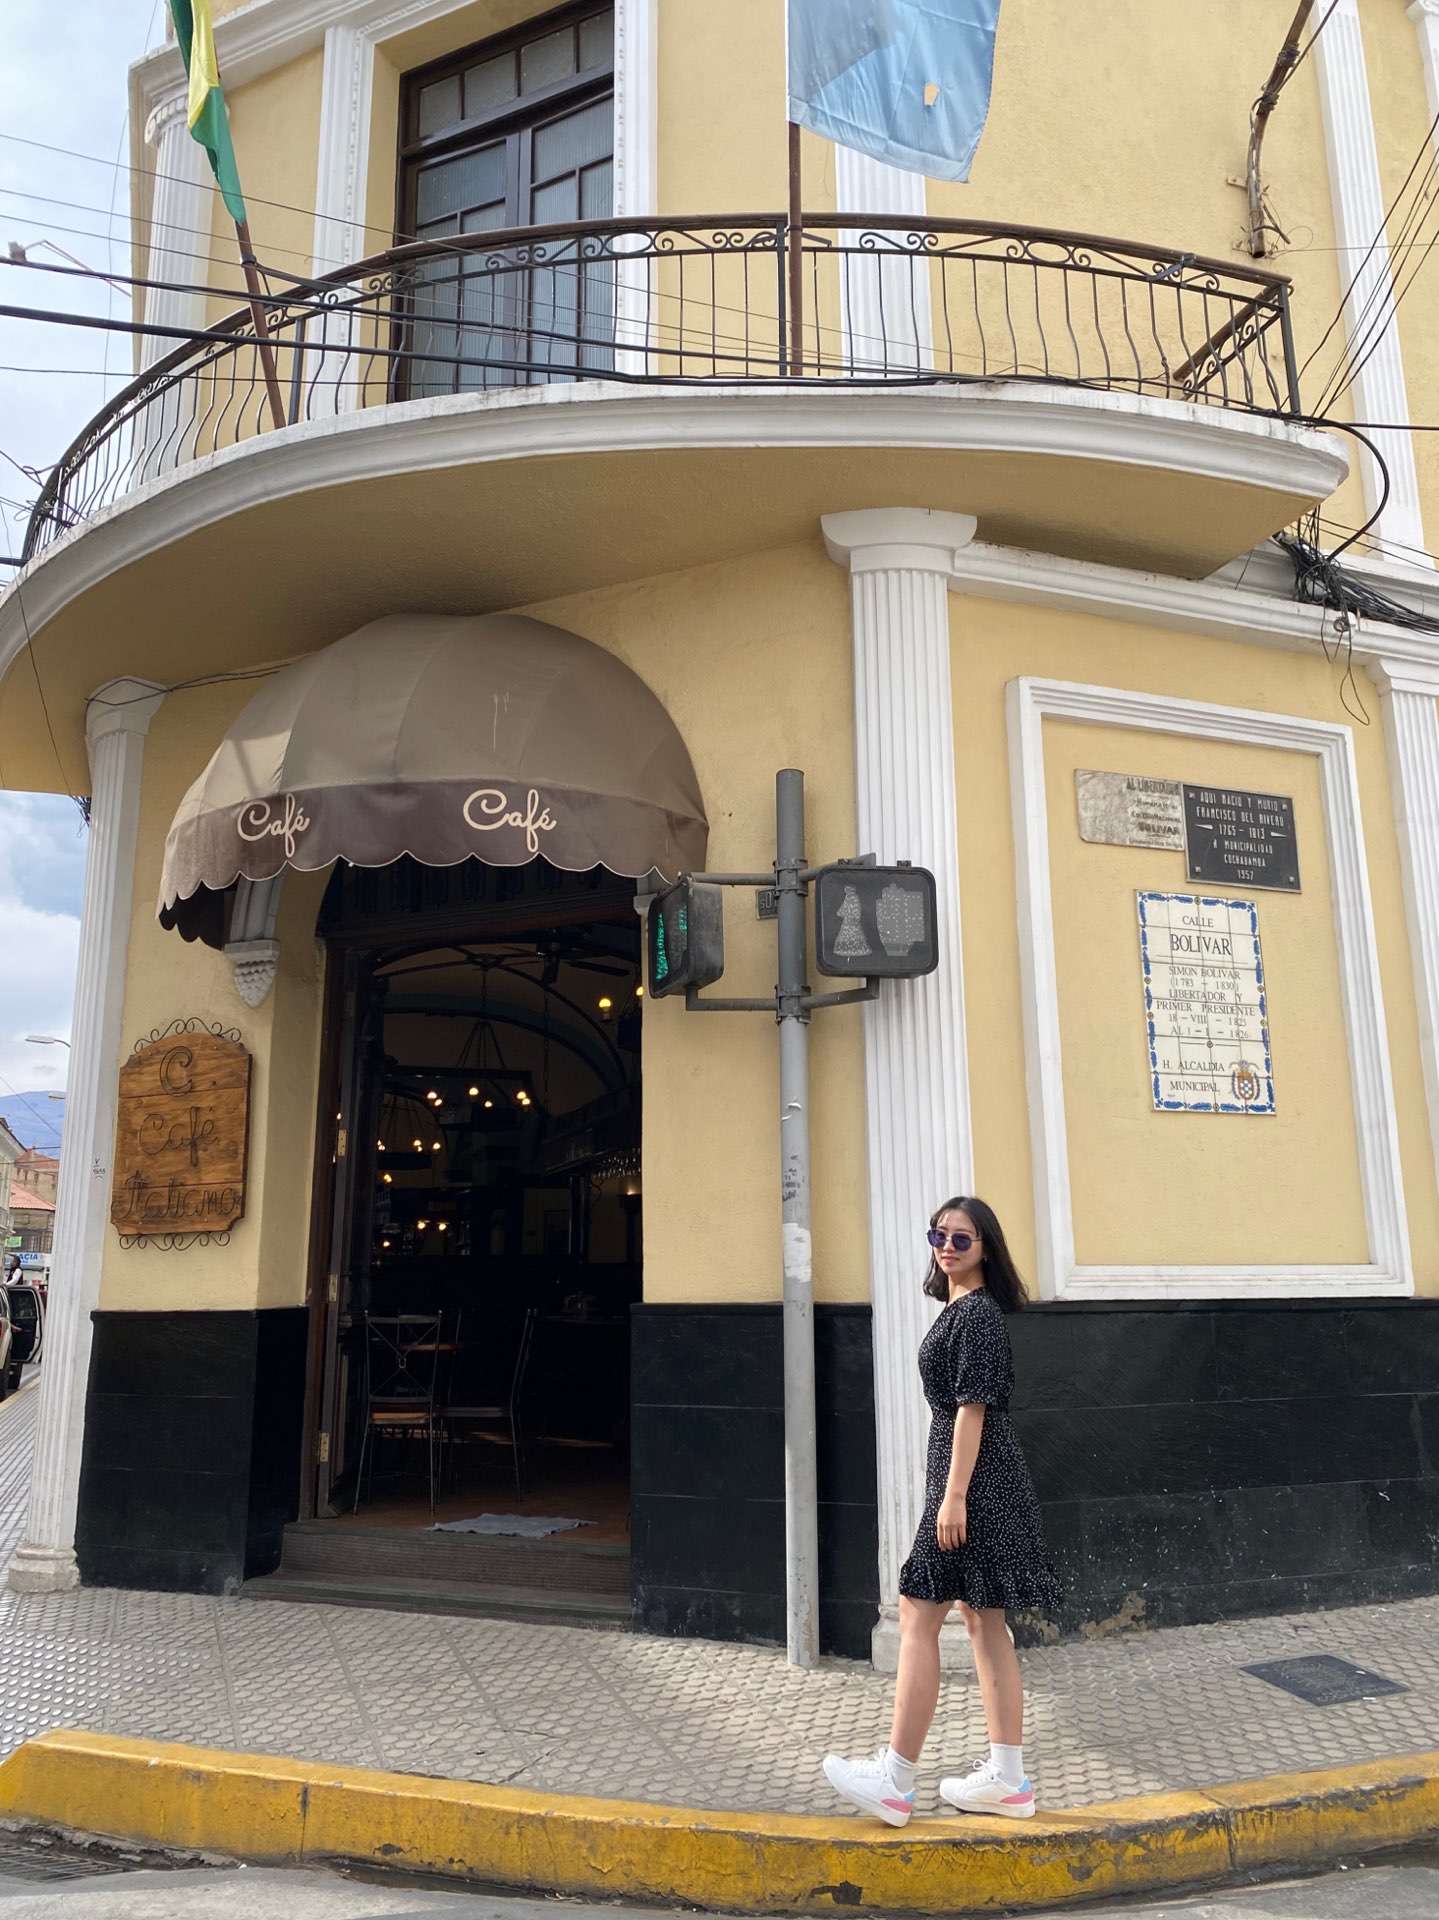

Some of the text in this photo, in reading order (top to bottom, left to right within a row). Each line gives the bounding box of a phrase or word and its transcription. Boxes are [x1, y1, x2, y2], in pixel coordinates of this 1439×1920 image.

[1200, 792, 1278, 812] AQUI NACIO Y MURIO
[463, 789, 557, 853] Café
[1196, 806, 1284, 827] FRANCISCO DEL RIVERO
[237, 792, 310, 858] Café
[1219, 824, 1236, 836] 1765
[1248, 827, 1265, 840] 1813
[1224, 840, 1273, 855] MUNICIPALIDAD
[1224, 854, 1266, 867] COCHABAMBA
[1182, 915, 1214, 928] CALLE
[1170, 933, 1232, 956] BOLIVAR
[1168, 966, 1241, 980] SIMON BOLIVAR
[1169, 989, 1243, 1003] LIBERTADOR Y
[1156, 1000, 1255, 1016] PRIMER PRESIDENTE
[1169, 1013, 1177, 1022] 18
[1171, 1026, 1184, 1035] AL
[159, 1045, 193, 1097] C
[1178, 1060, 1225, 1072] ALCALDIA
[1170, 1080, 1220, 1093] MUNICIPAL
[139, 1105, 218, 1167] Café
